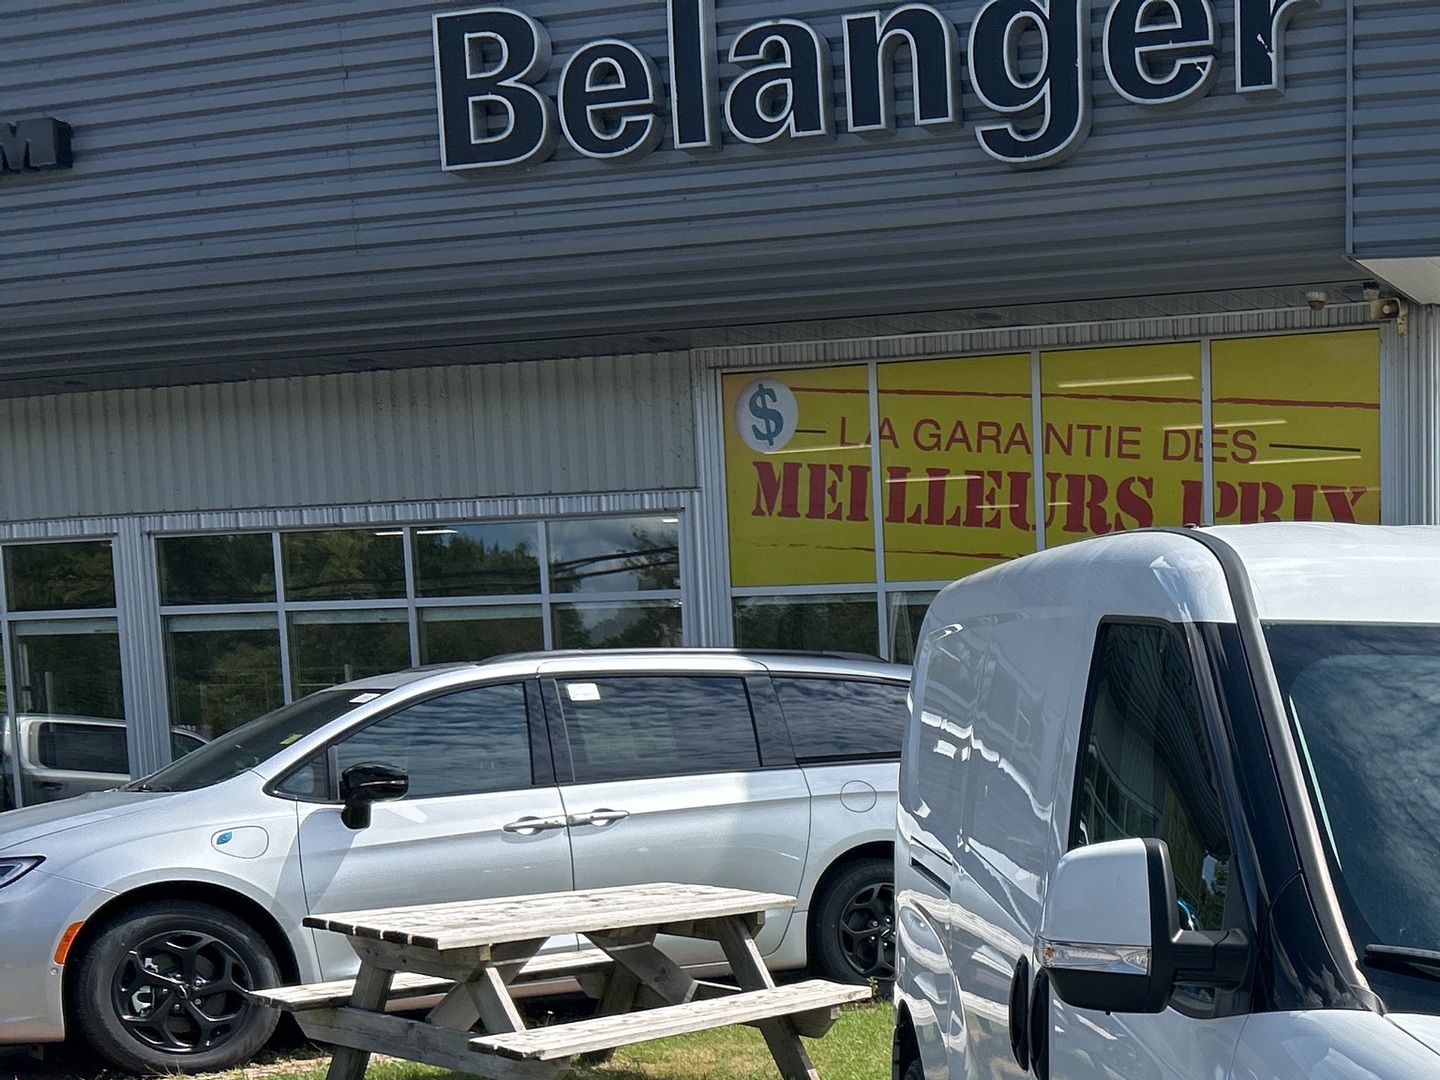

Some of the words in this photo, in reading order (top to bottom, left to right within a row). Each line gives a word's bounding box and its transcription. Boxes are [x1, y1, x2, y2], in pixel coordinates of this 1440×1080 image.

[432, 0, 1312, 170] Belanger
[839, 416, 900, 449] LA
[913, 418, 1142, 460] GARANTIE
[1162, 428, 1258, 464] DES
[751, 461, 1154, 535] MEILLEURS
[1181, 479, 1368, 525] PRIX
